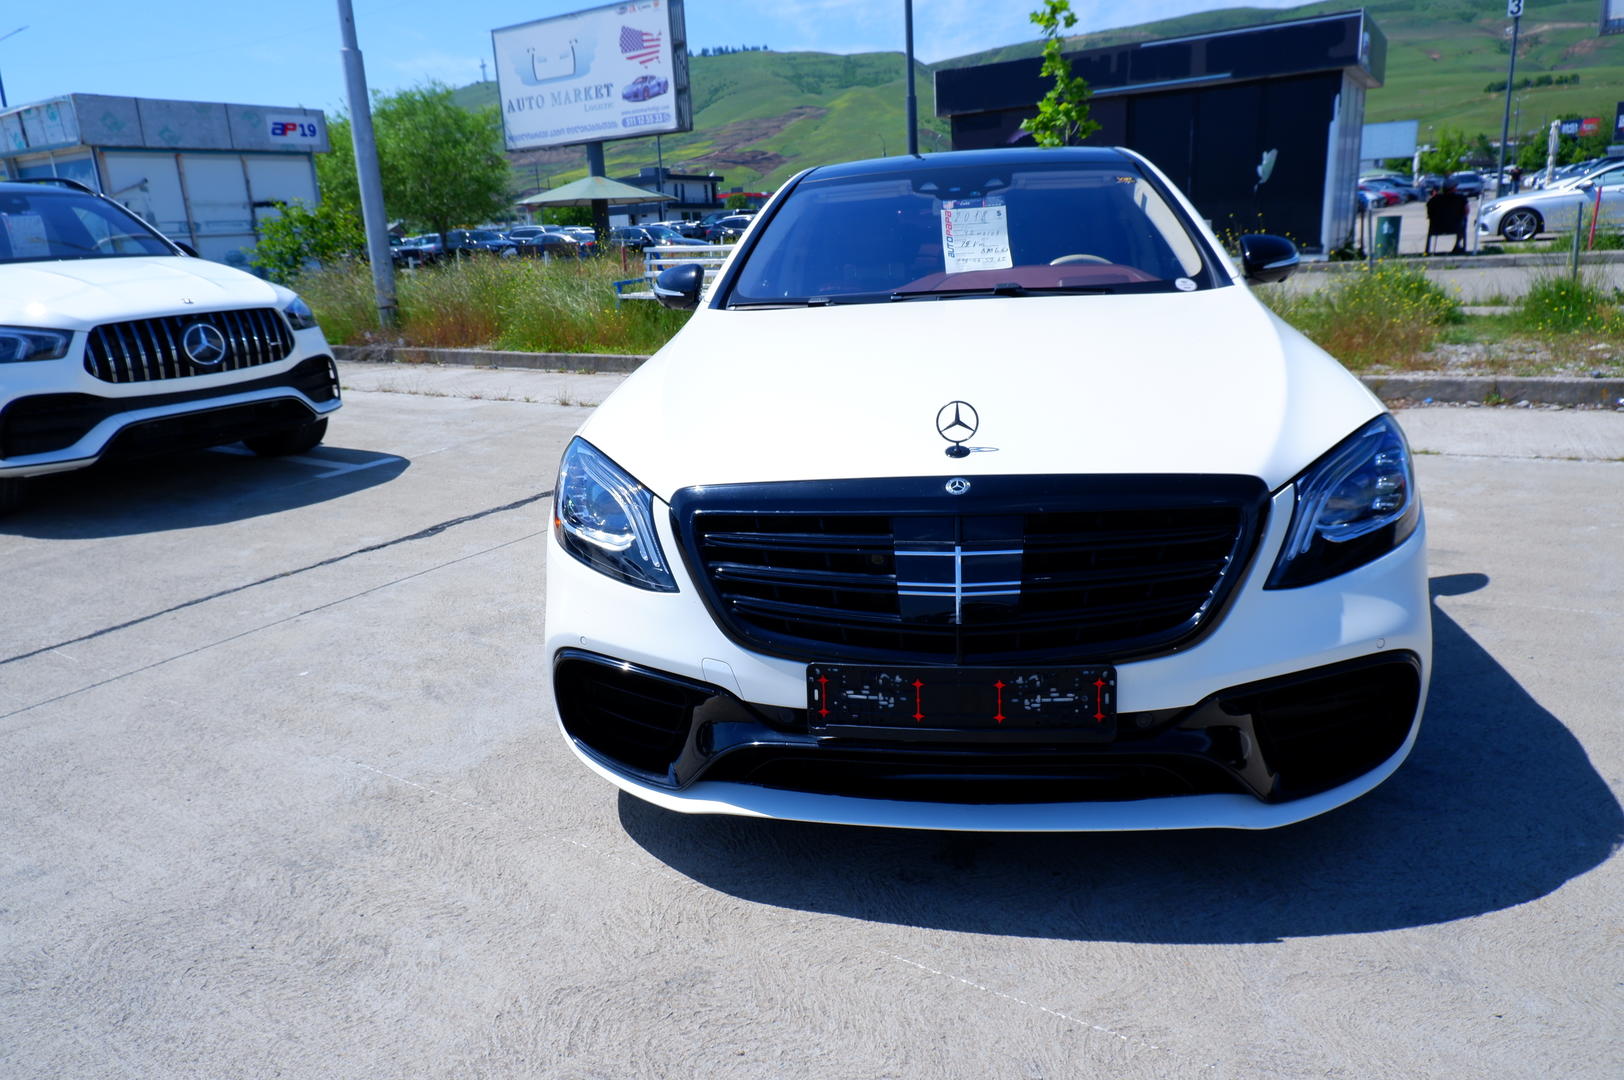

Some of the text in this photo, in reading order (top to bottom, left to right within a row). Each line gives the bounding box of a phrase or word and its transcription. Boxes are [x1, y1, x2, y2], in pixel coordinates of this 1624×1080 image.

[1510, 0, 1522, 15] 3
[507, 82, 614, 114] AUTO MARKET
[298, 122, 317, 137] 19
